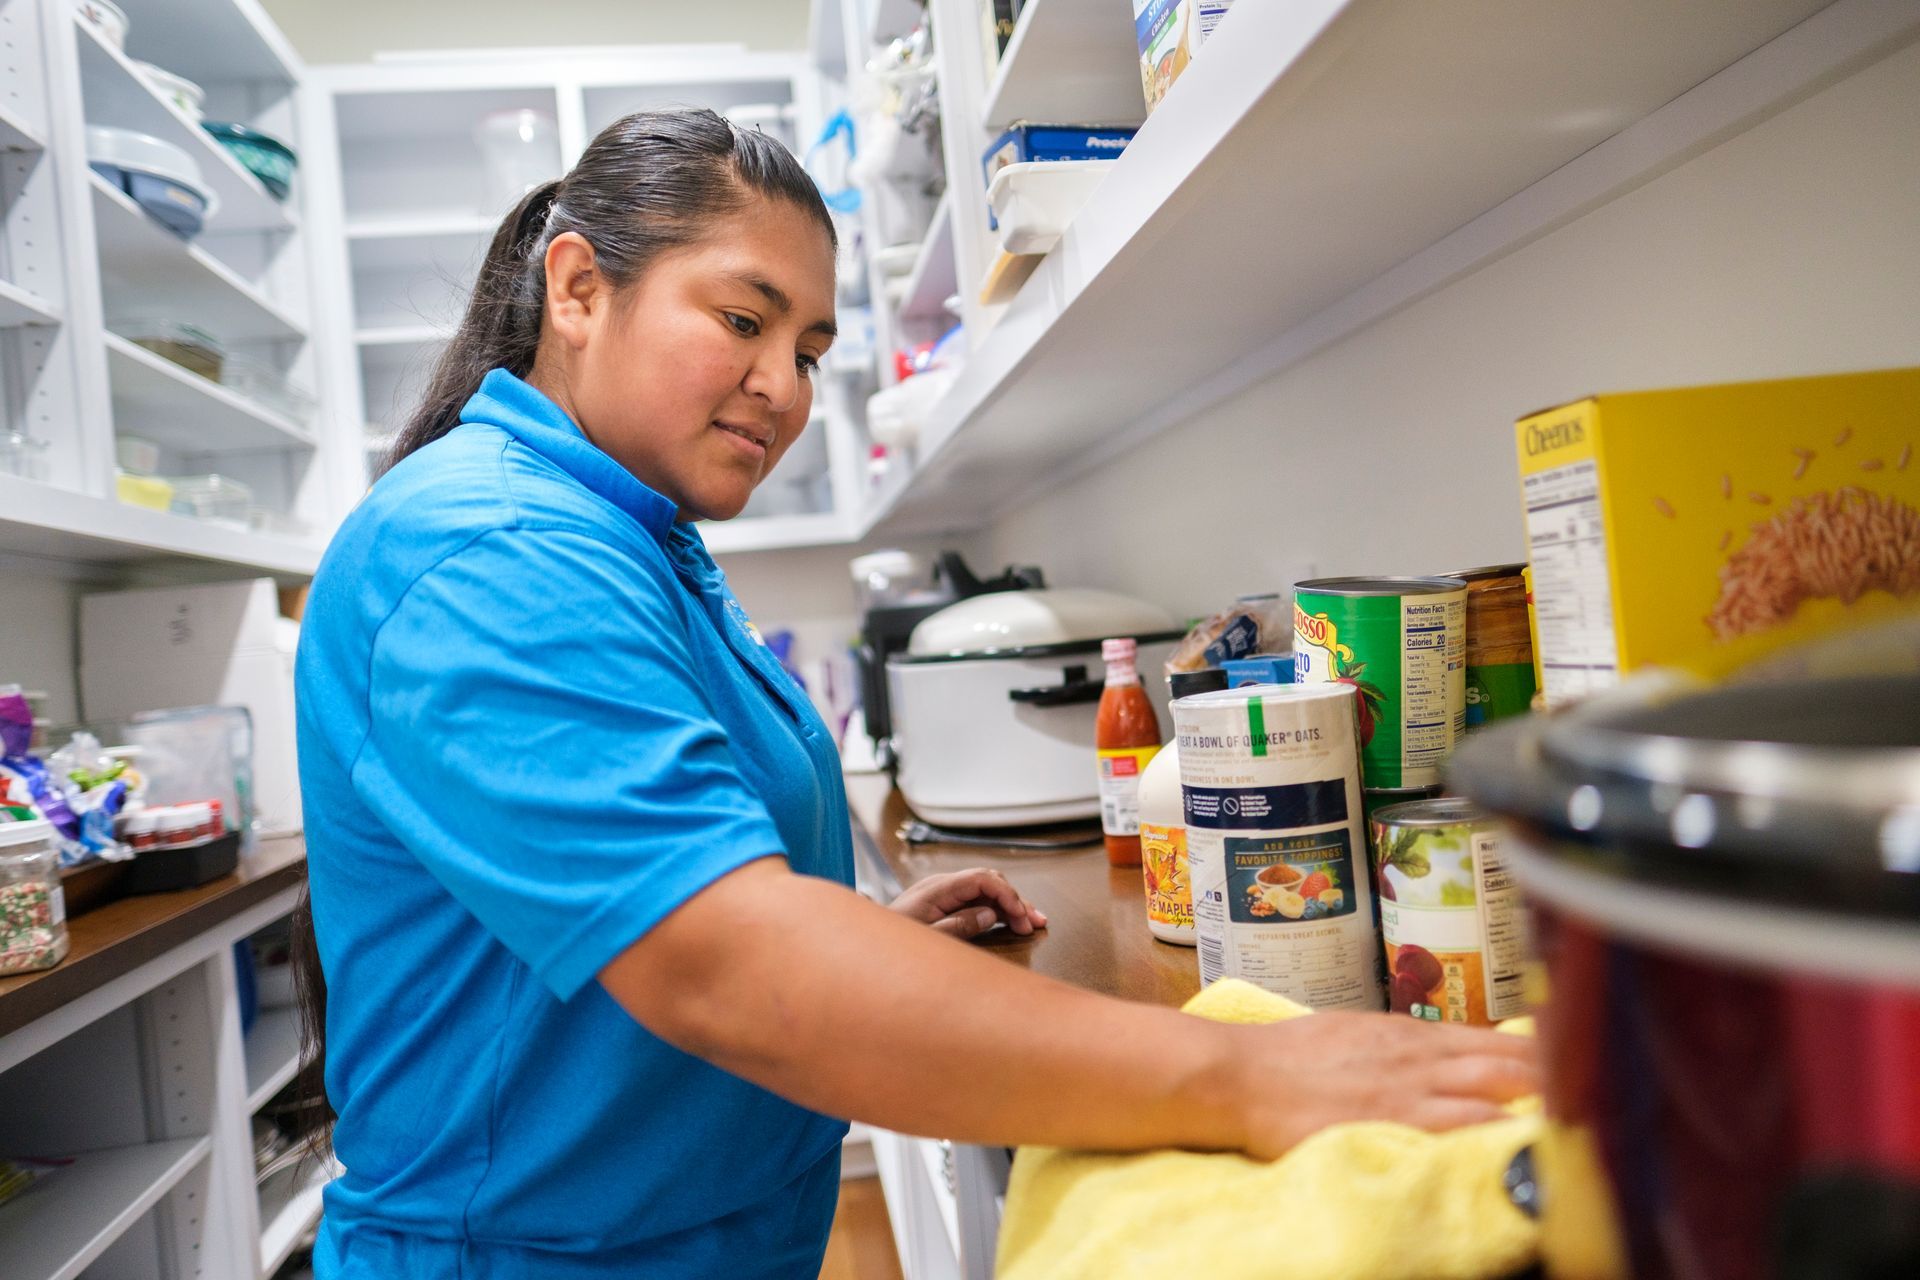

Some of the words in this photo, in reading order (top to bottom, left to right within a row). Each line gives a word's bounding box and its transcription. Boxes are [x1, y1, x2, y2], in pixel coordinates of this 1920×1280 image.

[1407, 607, 1431, 615] Nutrition
[1432, 605, 1445, 614] Facts
[1407, 638, 1432, 647] Calories
[1437, 634, 1445, 646] 20
[1193, 736, 1198, 748] A
[1199, 736, 1224, 748] BOWL
[1226, 736, 1239, 748] OF
[1289, 840, 1316, 849] YOUR
[1235, 854, 1284, 866] FAVORITE
[1158, 901, 1193, 917] MAPLE
